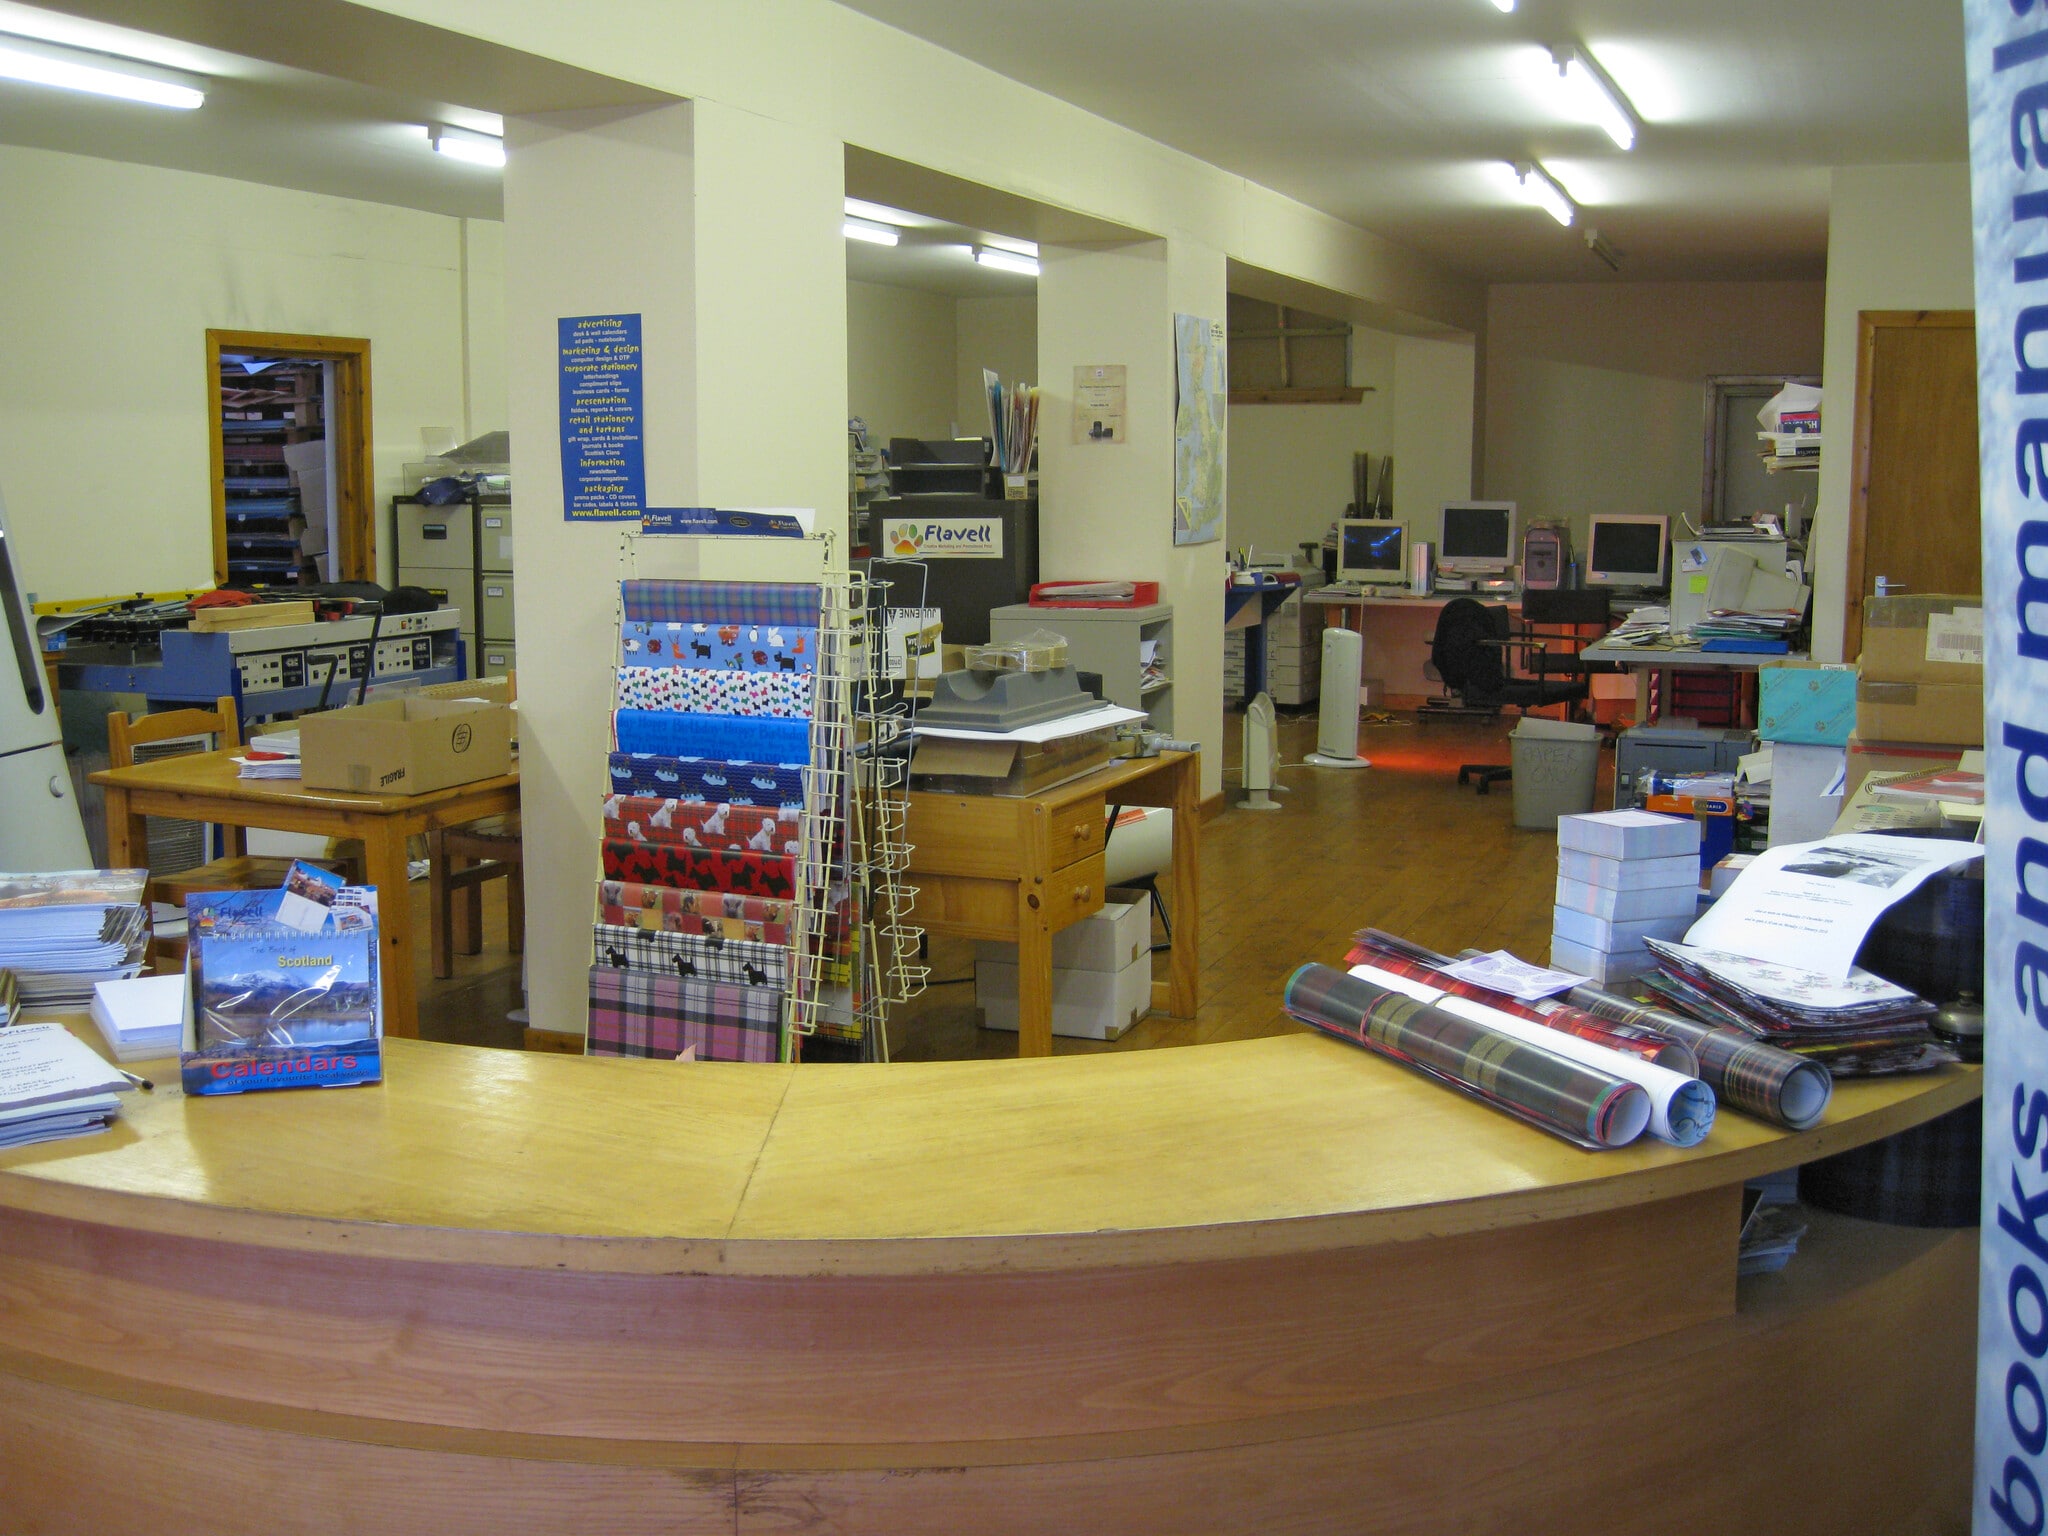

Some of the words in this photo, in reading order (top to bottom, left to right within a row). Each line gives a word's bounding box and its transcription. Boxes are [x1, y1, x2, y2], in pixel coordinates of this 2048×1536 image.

[578, 319, 622, 328] advertising
[1993, 0, 2048, 658] manual
[563, 346, 600, 355] marketing
[604, 345, 610, 354] &
[614, 345, 639, 353] design
[601, 363, 637, 371] stationery
[576, 396, 626, 405] presentation
[569, 416, 590, 424] retail
[594, 415, 634, 423] stationery
[579, 426, 592, 434] and
[580, 459, 625, 467] information
[584, 484, 623, 493] packaging
[571, 509, 640, 517] www.flavell.com
[924, 525, 991, 542] Flavell
[899, 609, 936, 618] JULENNE
[380, 767, 405, 787] FRAGILE
[2002, 721, 2048, 1032] and
[278, 954, 332, 967] Scotland
[210, 1055, 358, 1079] Calendars
[241, 1078, 263, 1086] your
[266, 1075, 312, 1083] favourite
[1989, 1080, 2048, 1536] books
